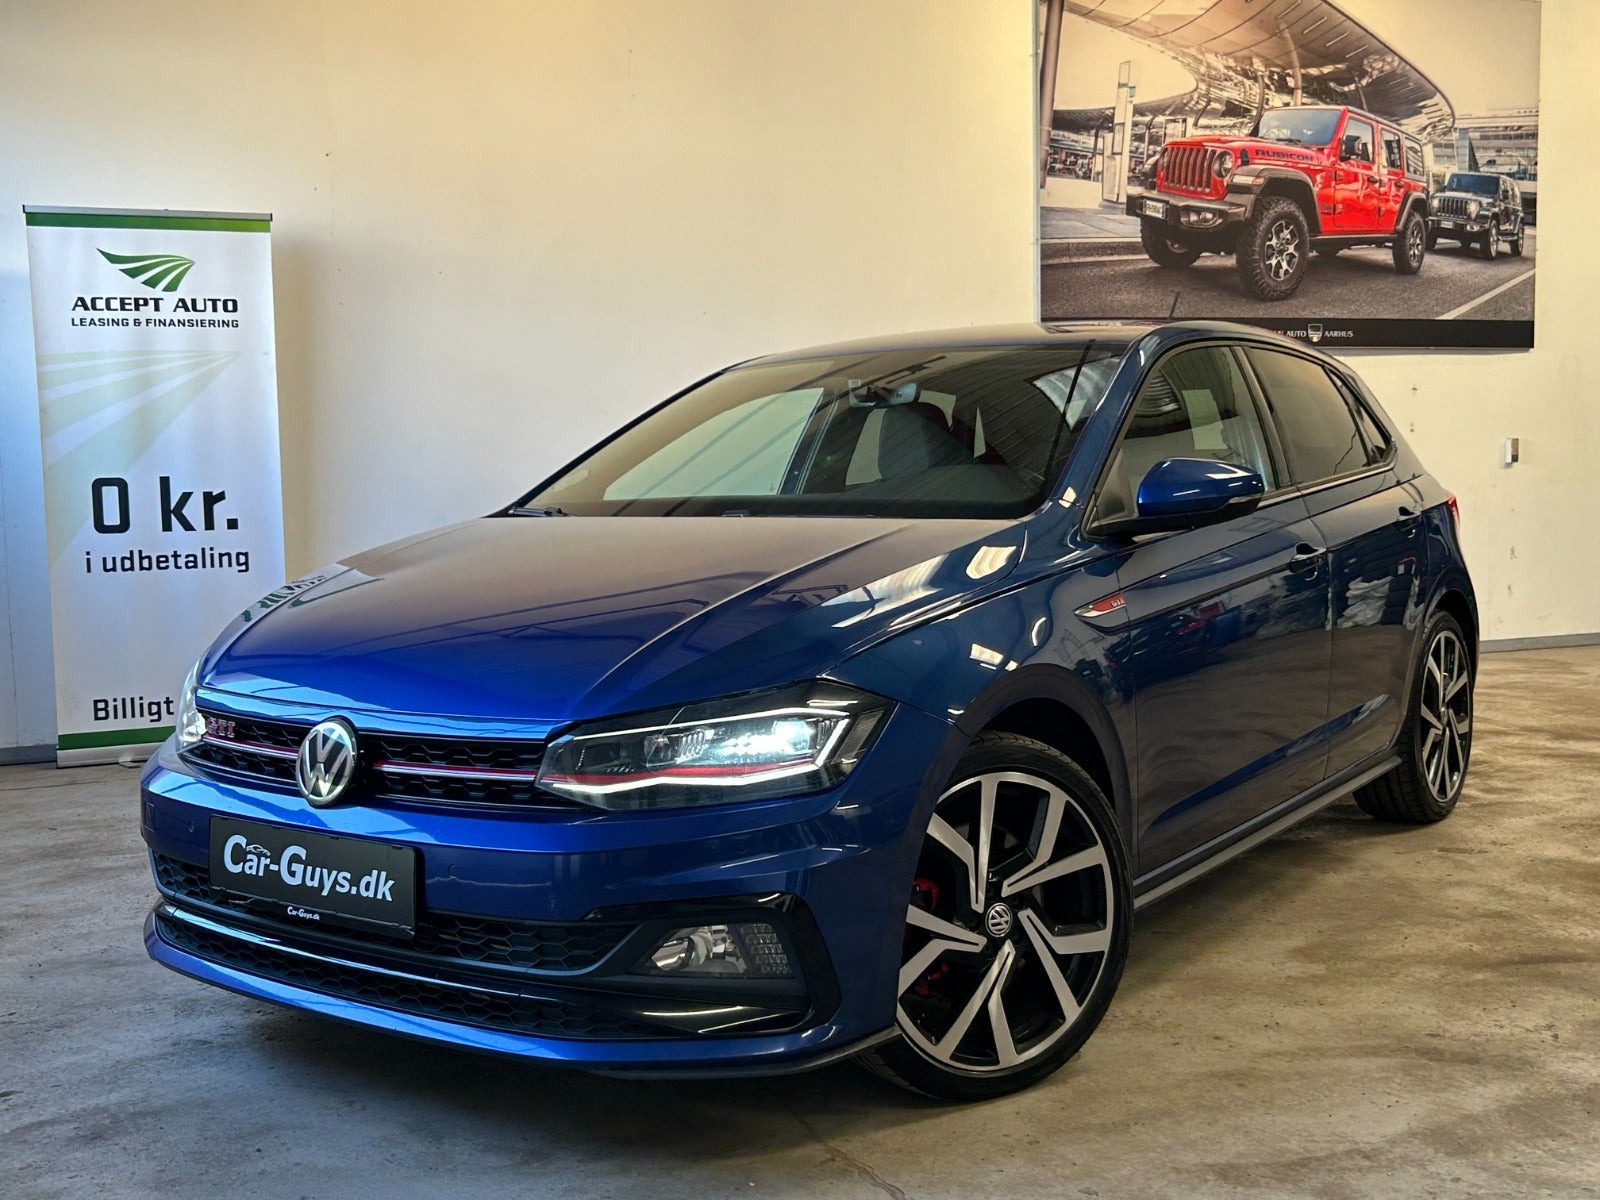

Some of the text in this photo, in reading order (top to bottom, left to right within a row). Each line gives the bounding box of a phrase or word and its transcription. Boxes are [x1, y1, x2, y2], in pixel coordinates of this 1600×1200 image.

[1254, 149, 1314, 162] RUBICON
[71, 296, 239, 313] ACCEPT AUTO
[71, 317, 240, 328] LEASING & FINANSIERING
[1286, 330, 1307, 338] AUTO
[1323, 330, 1354, 338] AARHUS
[159, 476, 239, 532] kr.
[85, 547, 250, 573] i udbetaling
[93, 696, 175, 722] Billigt
[207, 716, 236, 738] GTI
[223, 834, 395, 902] Car-Guys.dk
